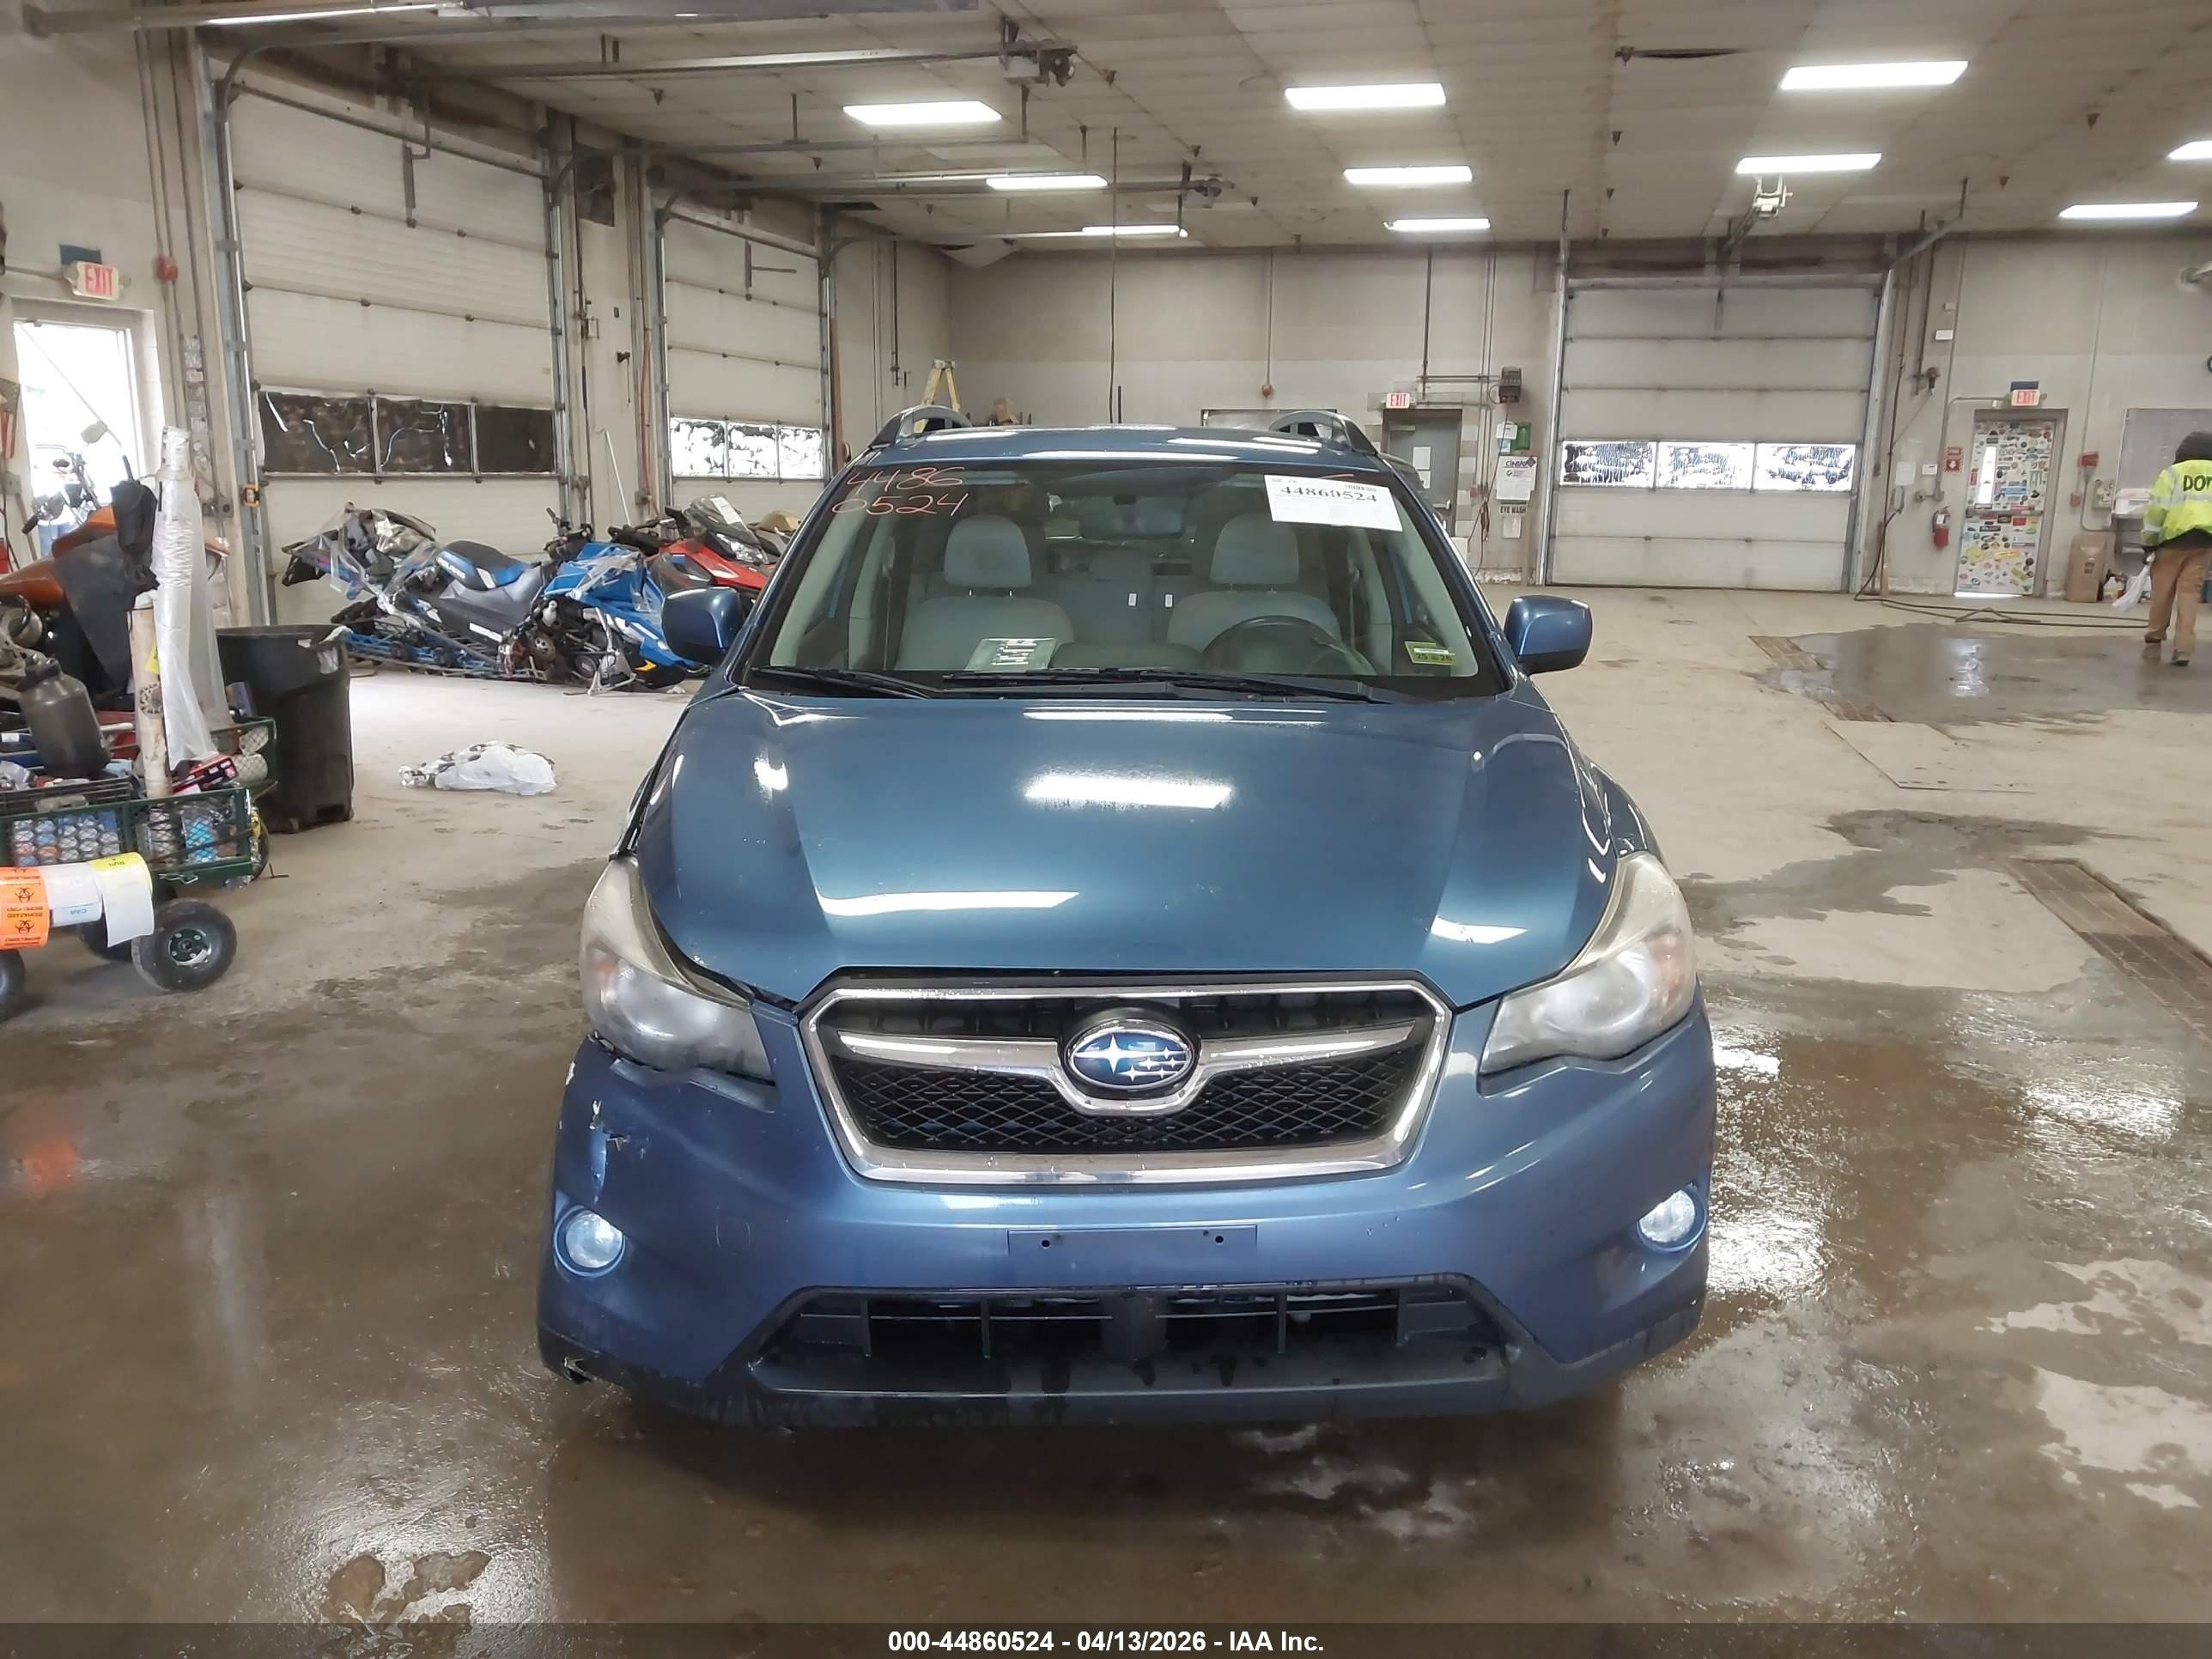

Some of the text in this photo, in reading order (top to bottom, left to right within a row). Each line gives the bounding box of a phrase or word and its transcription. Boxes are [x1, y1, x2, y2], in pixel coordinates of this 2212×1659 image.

[84, 264, 113, 296] EXIT
[1390, 393, 1407, 407] EXIT
[2016, 390, 2036, 404] EXIT
[847, 467, 965, 495] 4486
[1280, 485, 1377, 501] 44860524
[830, 493, 969, 517] 0524
[1500, 506, 1527, 514] EYE WASH
